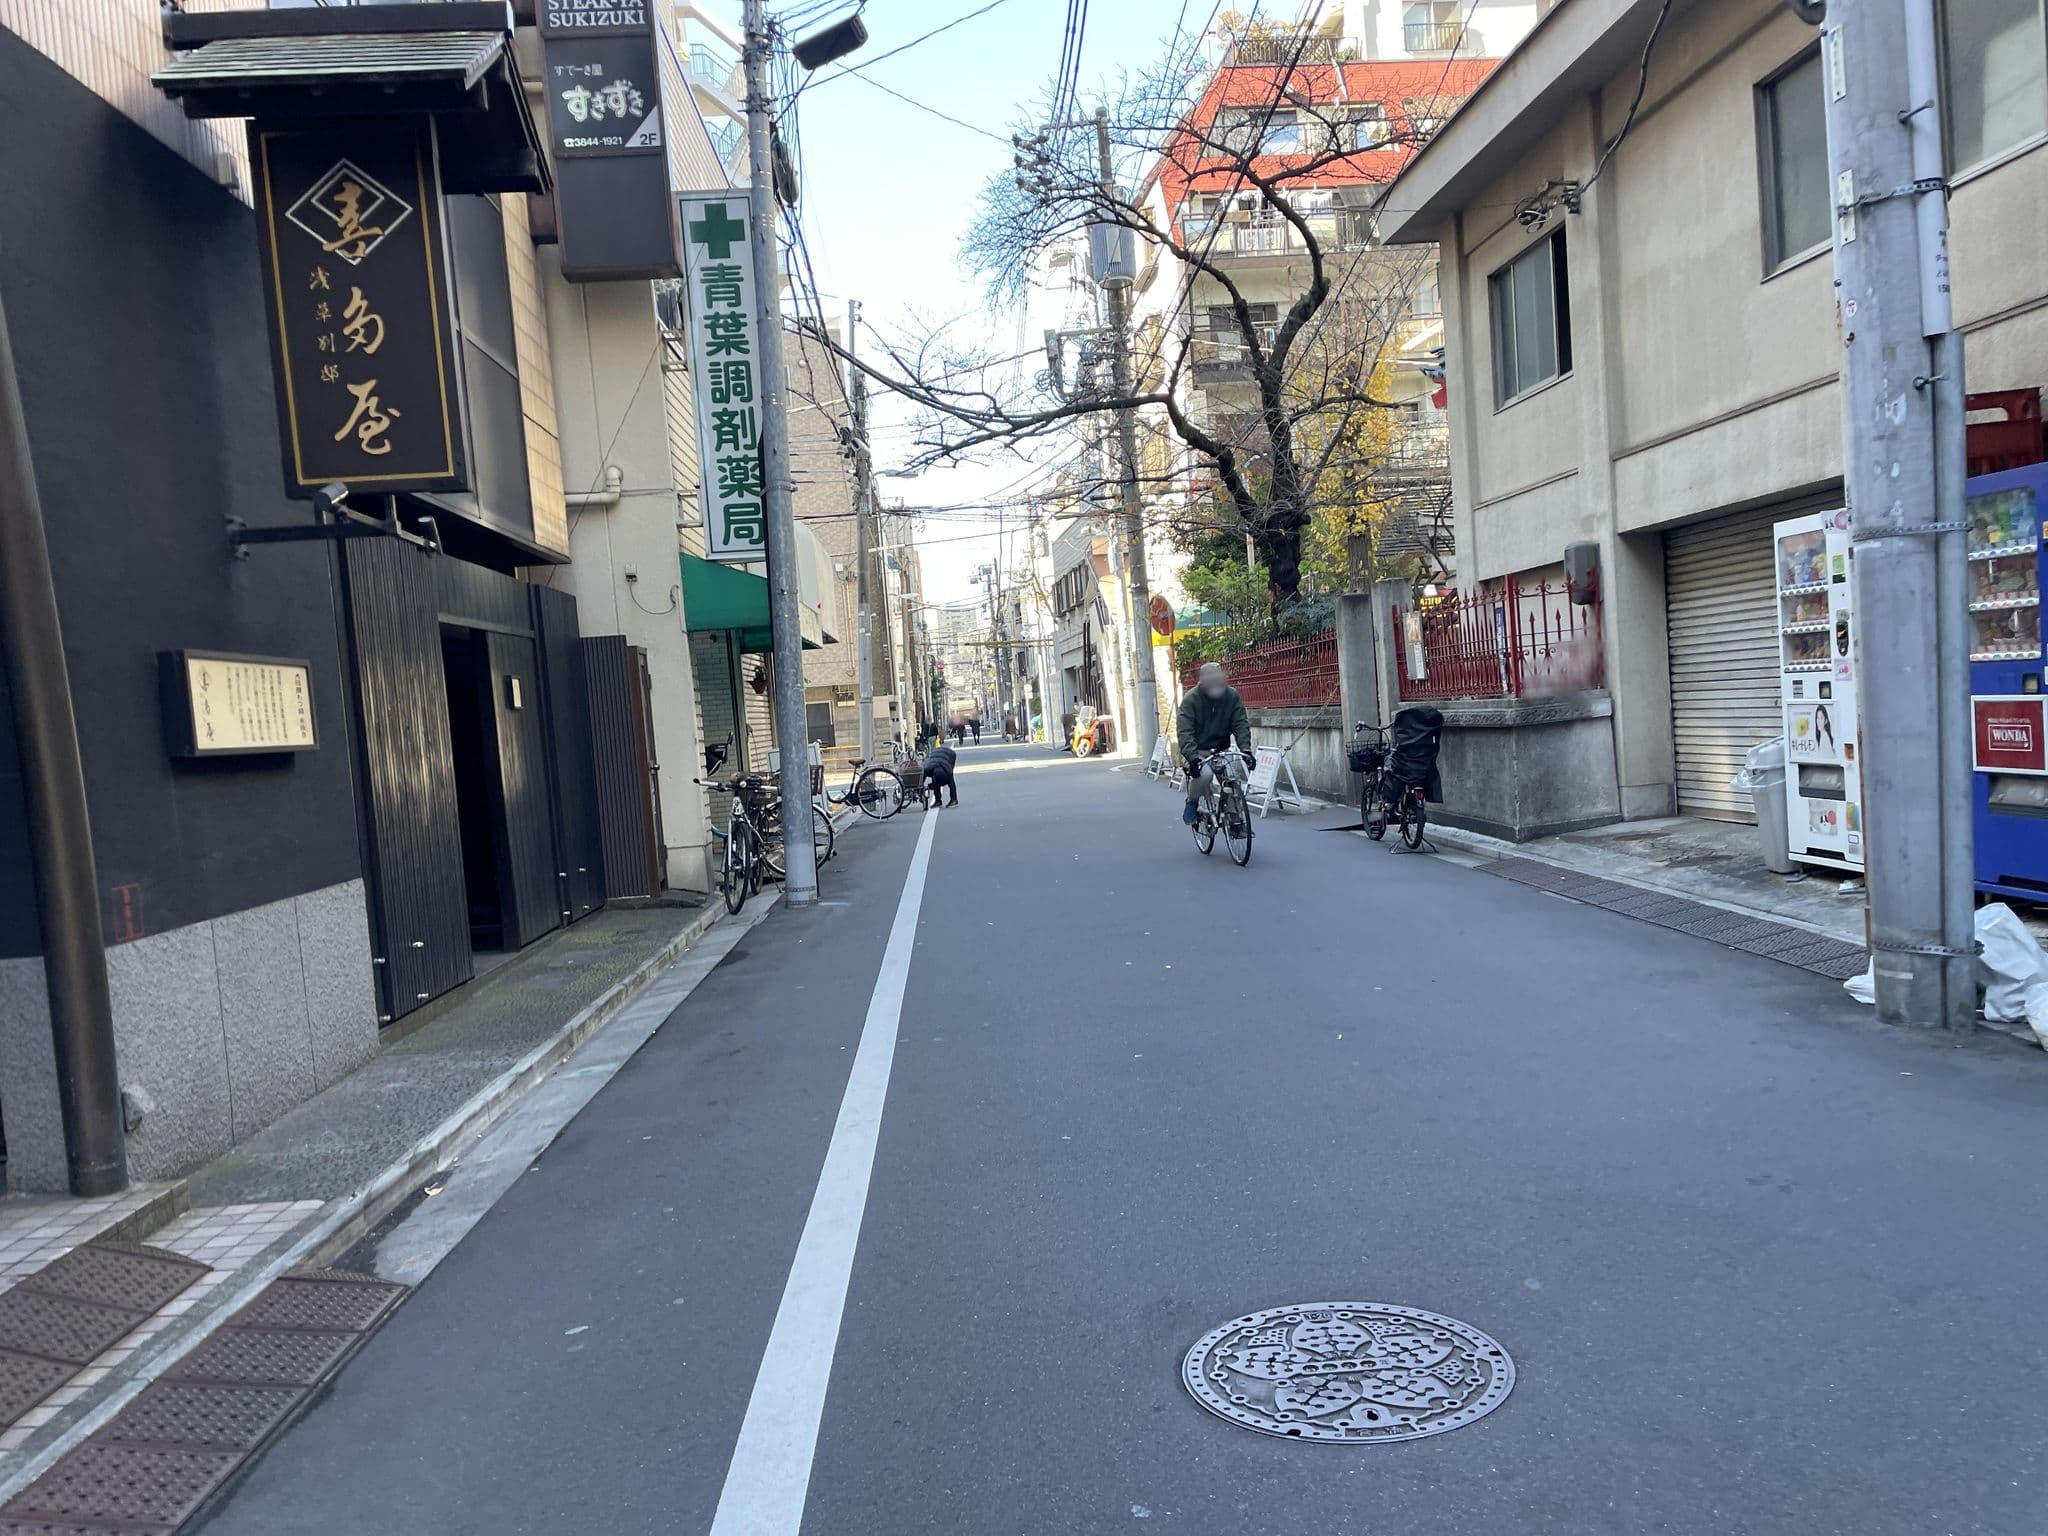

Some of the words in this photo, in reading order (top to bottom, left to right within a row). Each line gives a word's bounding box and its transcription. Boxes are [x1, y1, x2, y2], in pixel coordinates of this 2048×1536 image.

[549, 10, 645, 27] SUKIZUKI
[574, 137, 623, 146] 3844-1921
[639, 133, 657, 146] 2F
[699, 263, 765, 547] 青葉調剤薬局
[1992, 728, 2028, 742] WONDA
